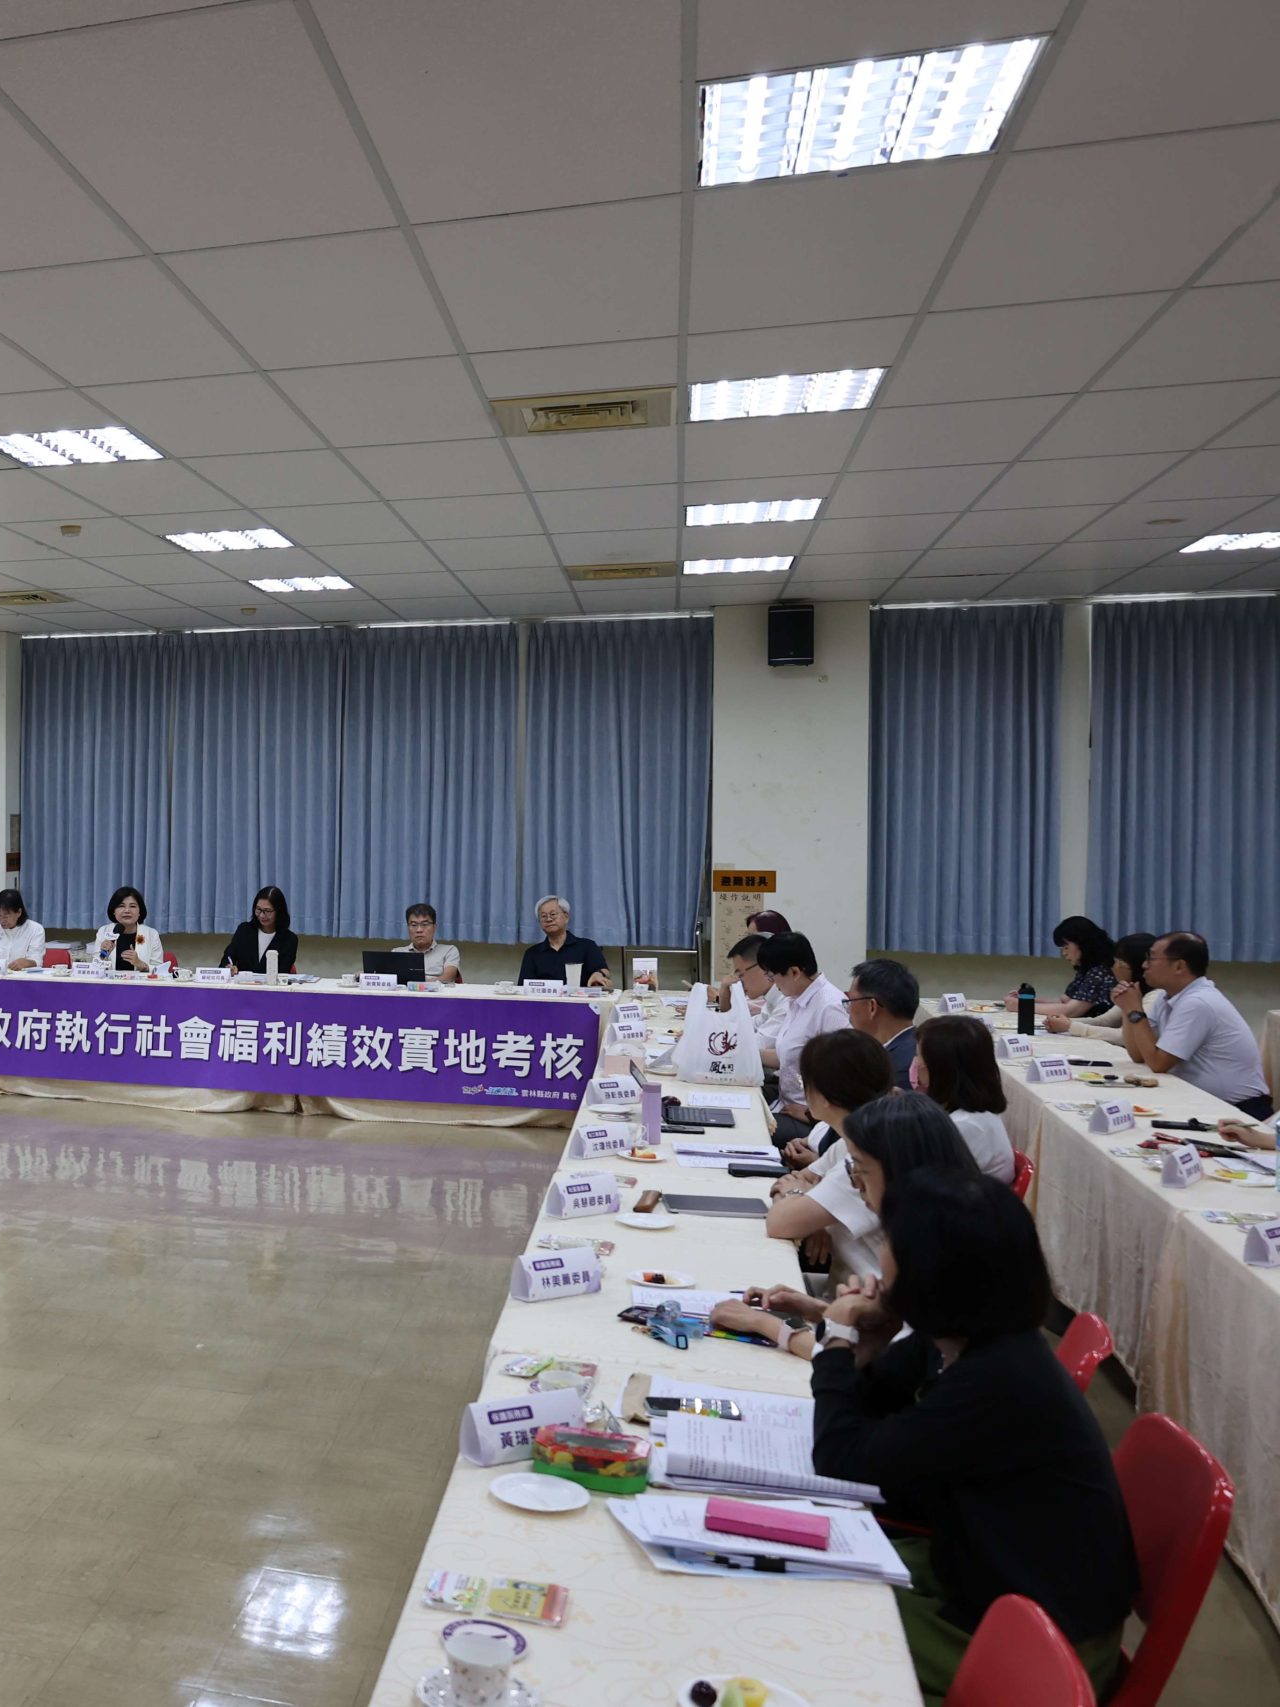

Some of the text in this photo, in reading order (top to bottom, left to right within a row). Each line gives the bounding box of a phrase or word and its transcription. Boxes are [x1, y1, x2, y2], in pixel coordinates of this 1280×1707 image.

[521, 1089, 560, 1100] 雲林縣政府
